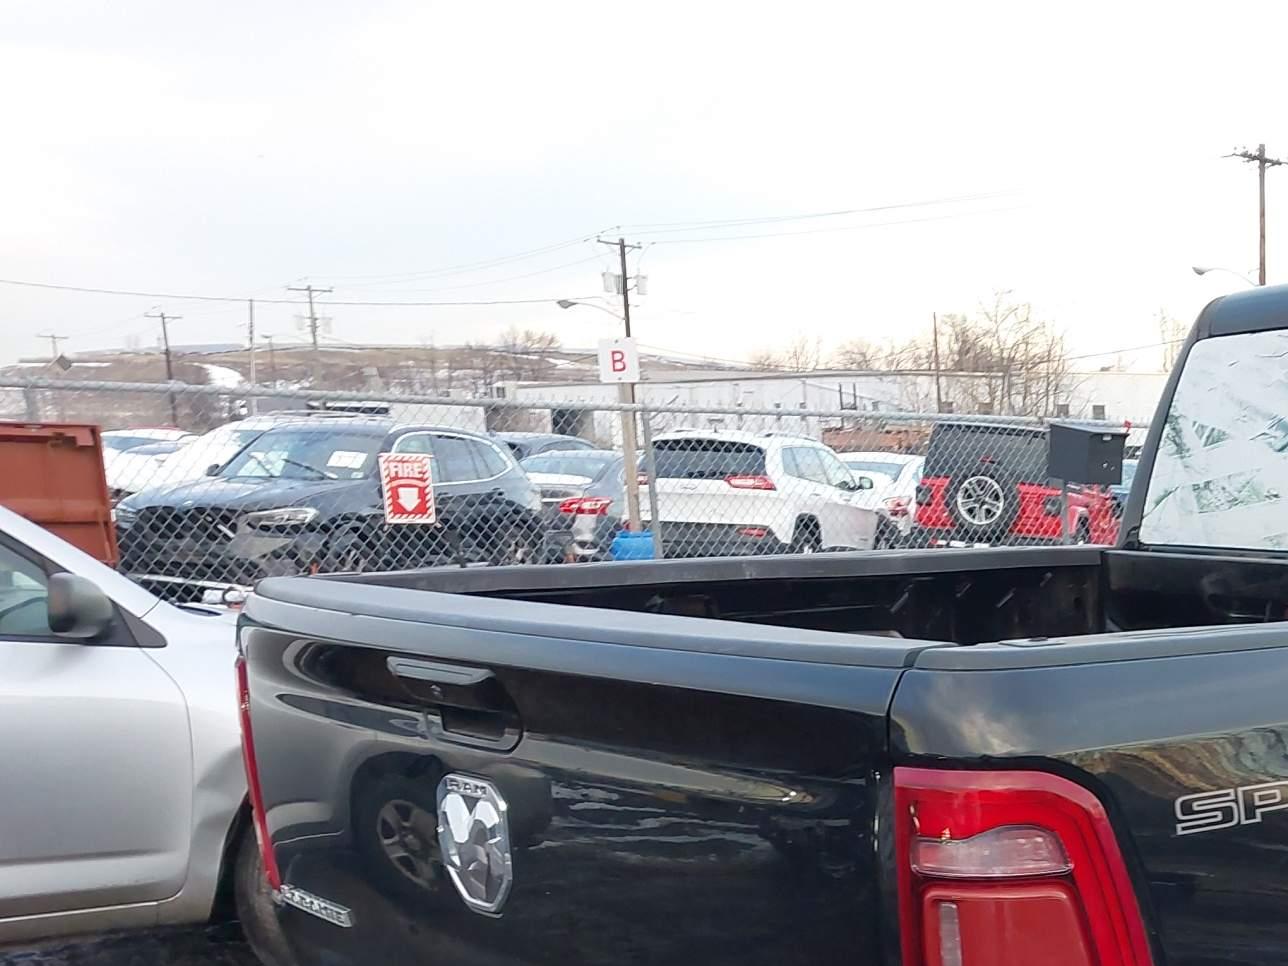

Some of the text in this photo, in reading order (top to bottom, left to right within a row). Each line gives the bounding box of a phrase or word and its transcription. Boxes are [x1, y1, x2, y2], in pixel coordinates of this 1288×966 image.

[611, 350, 626, 372] B
[389, 462, 425, 478] FIRE
[446, 779, 488, 797] RAM
